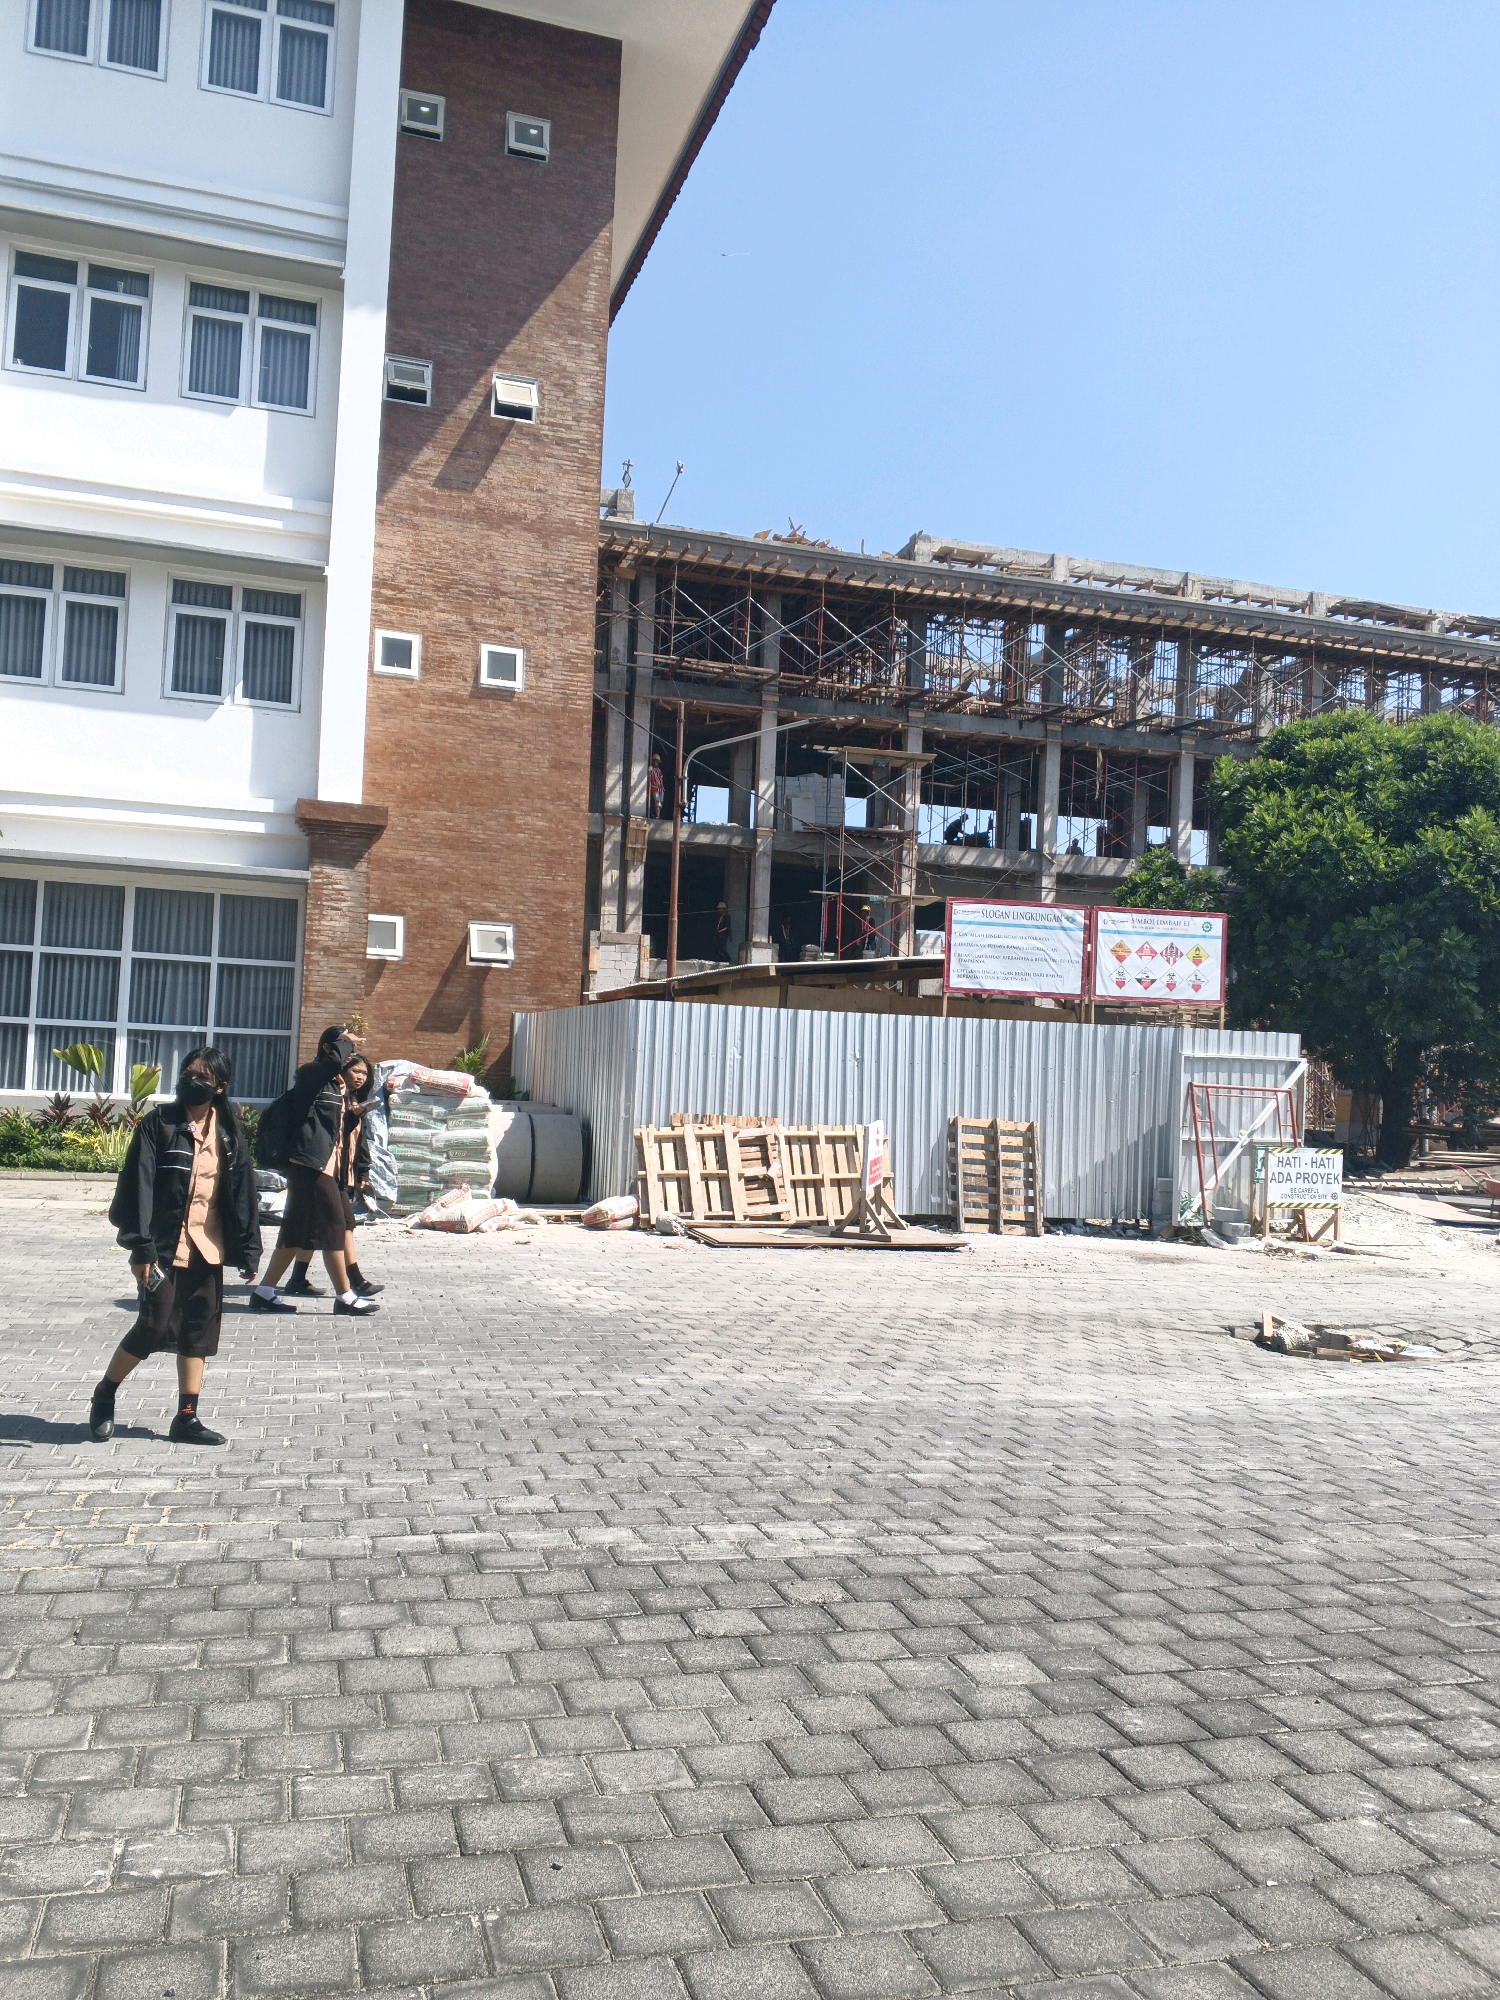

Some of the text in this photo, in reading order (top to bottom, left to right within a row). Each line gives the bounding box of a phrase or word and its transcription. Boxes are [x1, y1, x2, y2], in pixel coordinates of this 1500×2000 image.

[981, 909, 1010, 919] SLOGAN
[1012, 911, 1063, 922] LINGKUNGAN
[1132, 918, 1154, 926] SIMBOL
[1156, 919, 1181, 927] LIMBAH
[1277, 1156, 1301, 1168] HATI
[1311, 1157, 1334, 1169] HATI
[1270, 1171, 1340, 1184] ADA PROYEK
